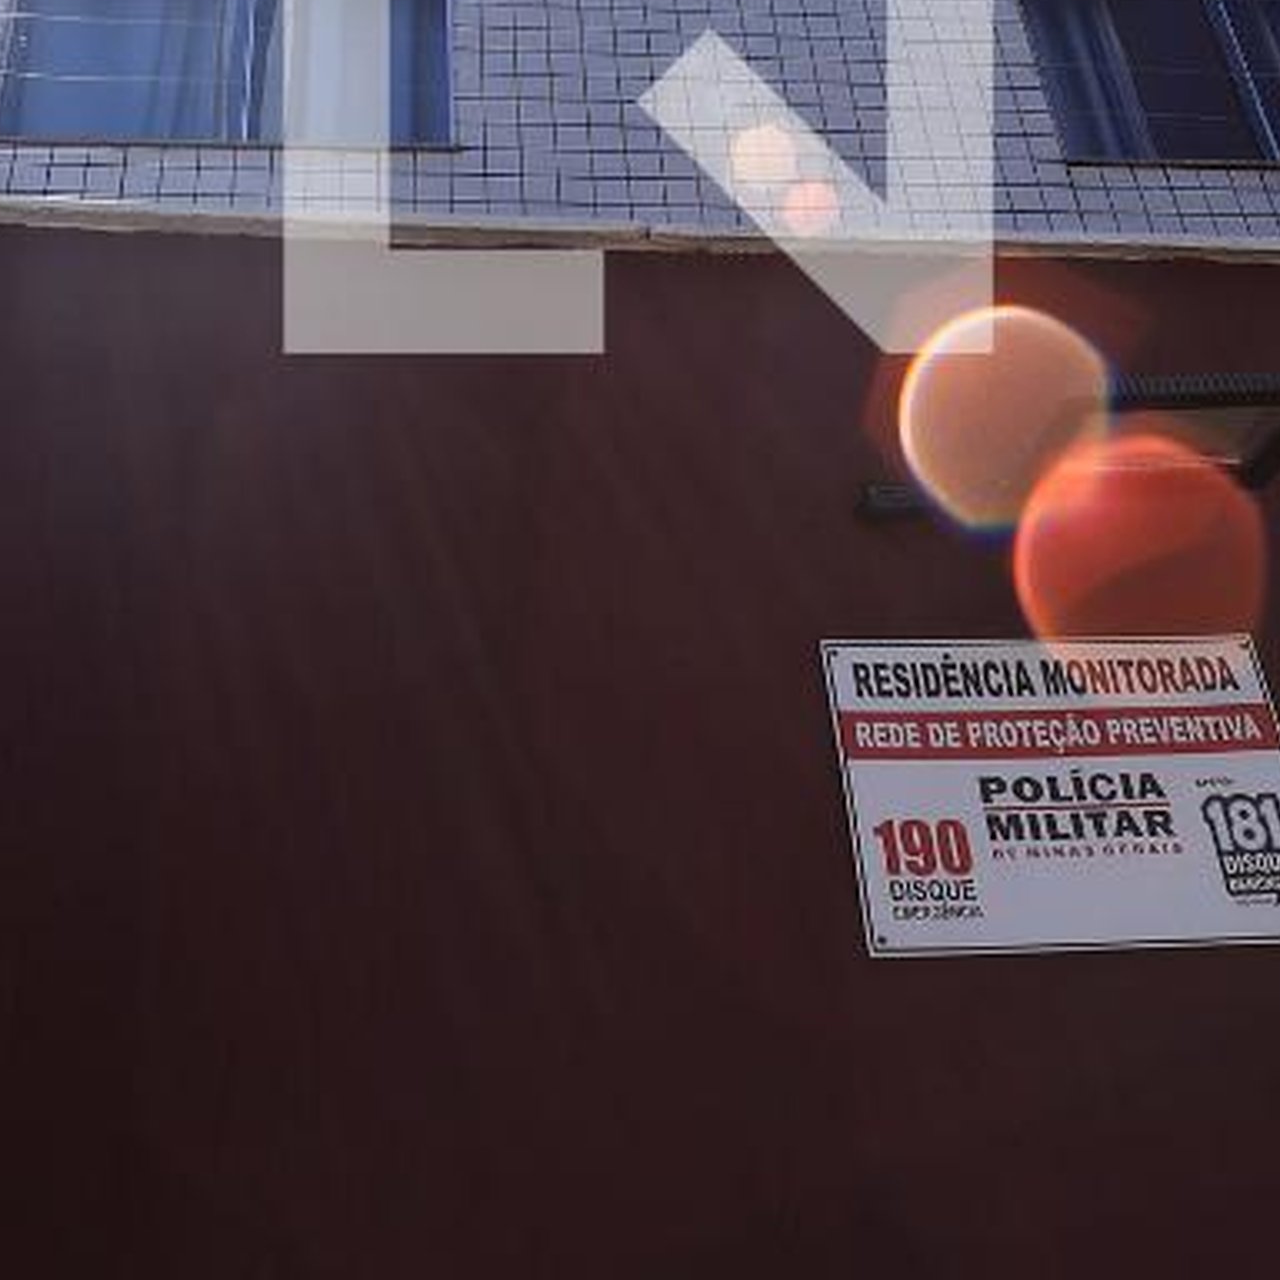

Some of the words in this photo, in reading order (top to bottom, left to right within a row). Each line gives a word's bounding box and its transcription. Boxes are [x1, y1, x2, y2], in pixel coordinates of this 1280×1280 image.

[852, 653, 1036, 699] RESIDÊNCIA
[1039, 655, 1240, 696] MONITORADA
[855, 721, 922, 748] REDE
[926, 721, 961, 748] DE
[966, 713, 1101, 754] PROTEÇÃO
[1106, 713, 1262, 745] PREVENTIVA
[978, 769, 1167, 803] POLÍCIA
[985, 810, 1176, 841] MILITAR
[873, 819, 973, 876] 190
[889, 879, 978, 901] DISQUE
